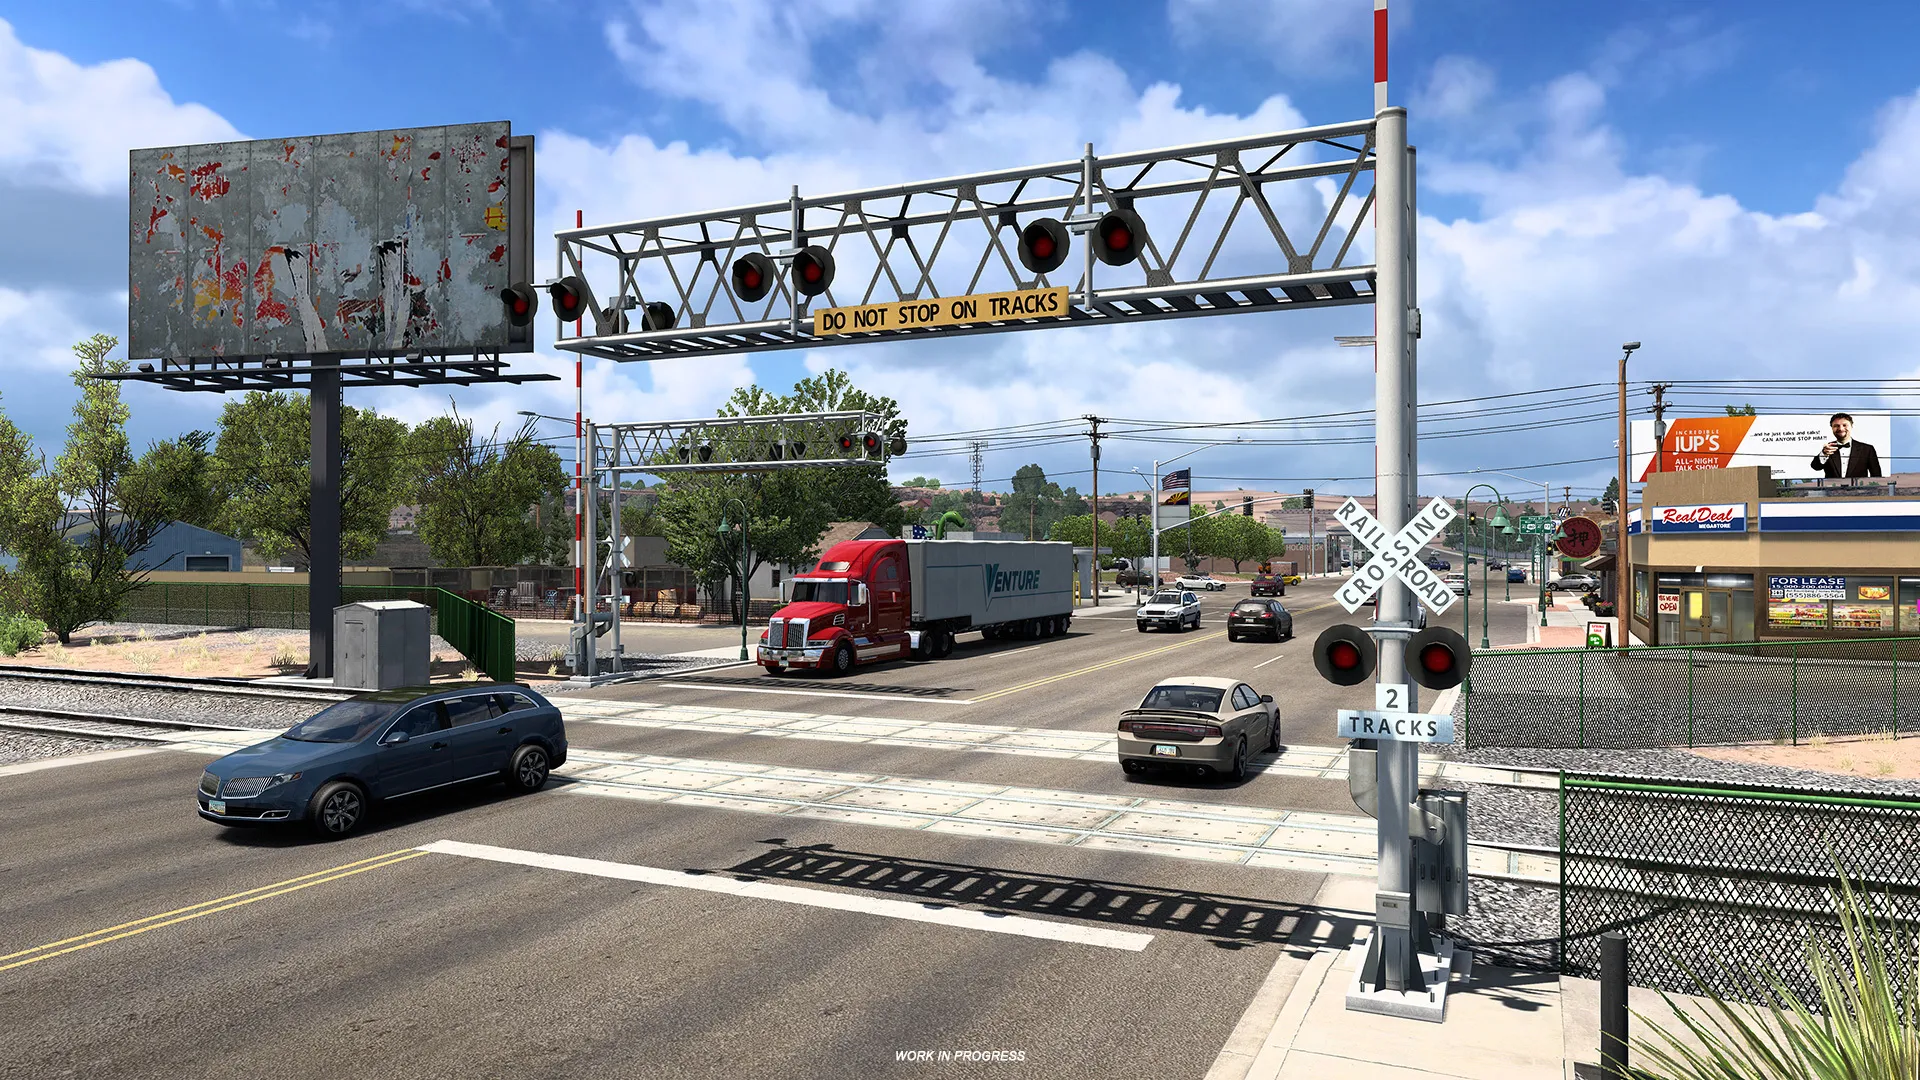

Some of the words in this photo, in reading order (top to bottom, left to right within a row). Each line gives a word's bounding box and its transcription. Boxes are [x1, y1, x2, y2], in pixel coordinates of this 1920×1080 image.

[823, 312, 846, 331] DO
[854, 308, 888, 328] NOT
[898, 303, 940, 324] STOP
[951, 300, 977, 320] ON
[989, 292, 1058, 316] TRACKS
[1673, 435, 1720, 455] JUP'S
[1339, 501, 1385, 550] RAIL
[1398, 558, 1450, 607] ROAD
[1342, 503, 1451, 605] CROSSING
[985, 563, 1041, 598] VENTURE
[1771, 577, 1798, 585] FOR
[1802, 577, 1845, 585] LEASE
[1659, 602, 1677, 611] OPEN
[1386, 688, 1398, 709] 2
[1349, 716, 1437, 737] TRACKS
